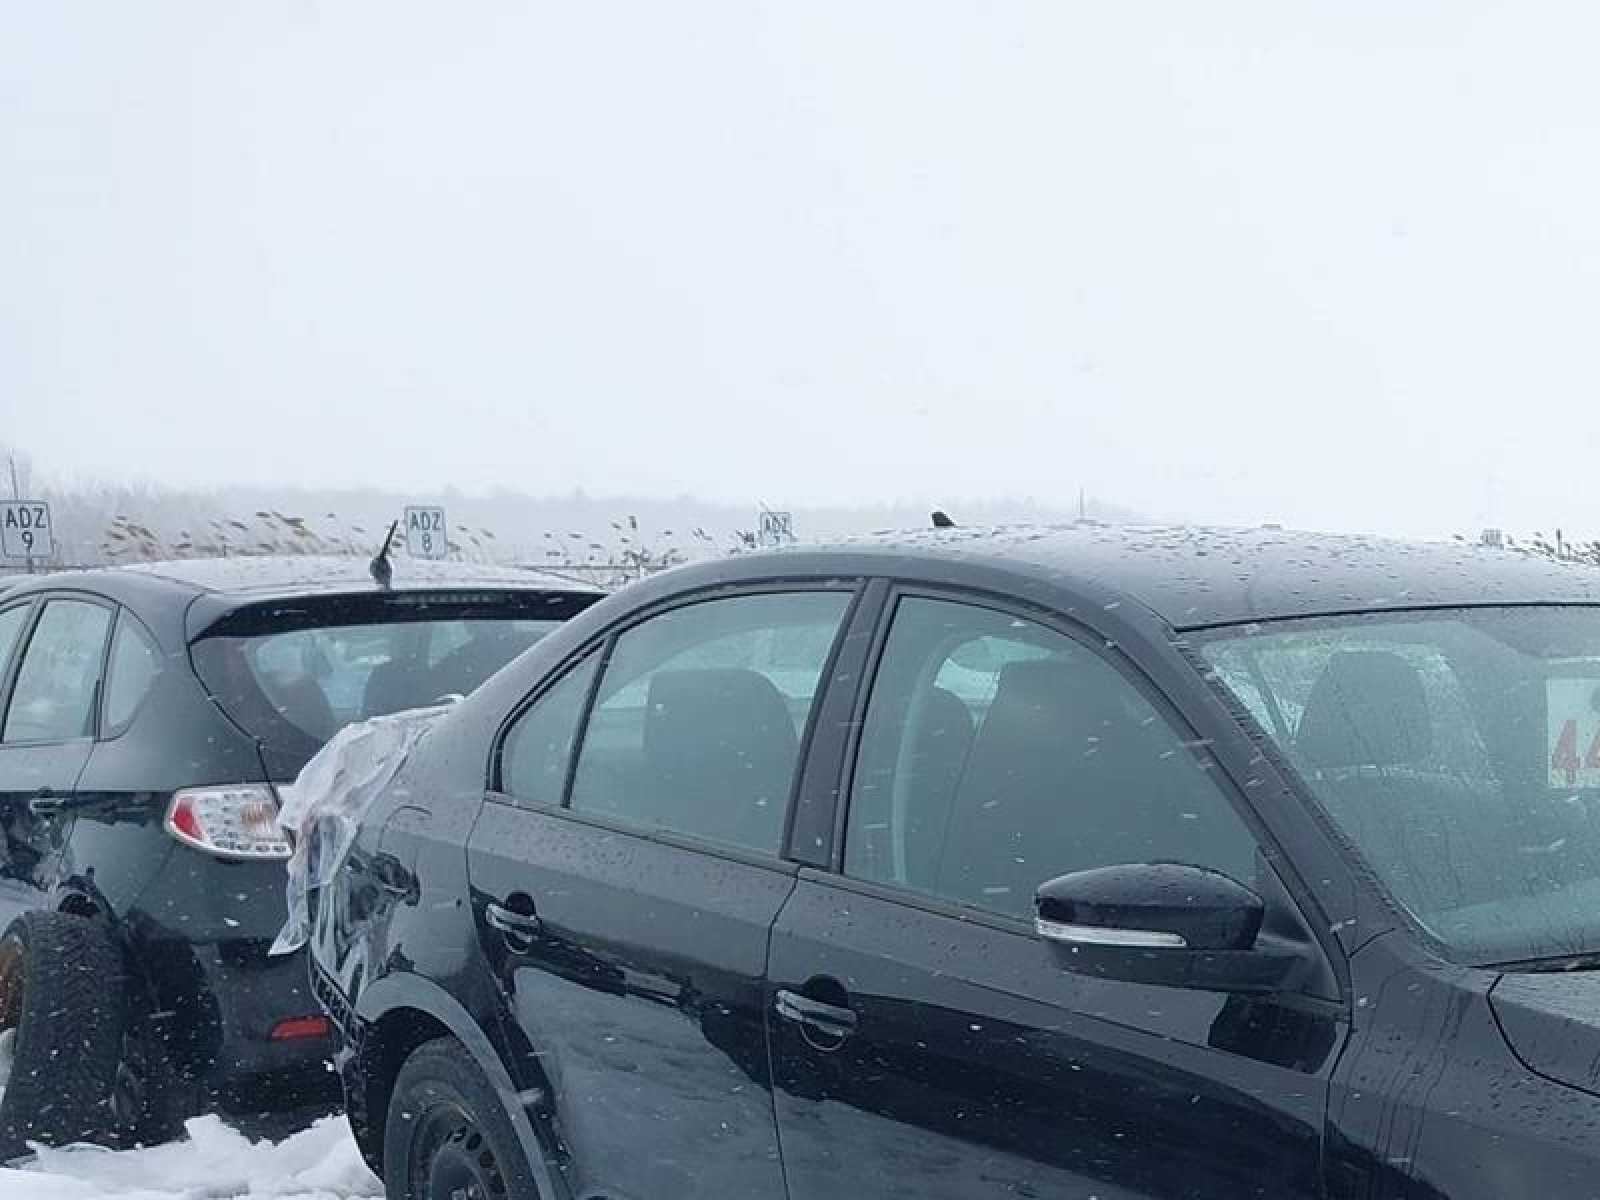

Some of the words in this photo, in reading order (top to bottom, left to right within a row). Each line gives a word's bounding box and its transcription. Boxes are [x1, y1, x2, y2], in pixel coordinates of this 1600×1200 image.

[5, 507, 46, 529] ADZ
[410, 511, 442, 531] ADZ
[21, 531, 33, 551] 9
